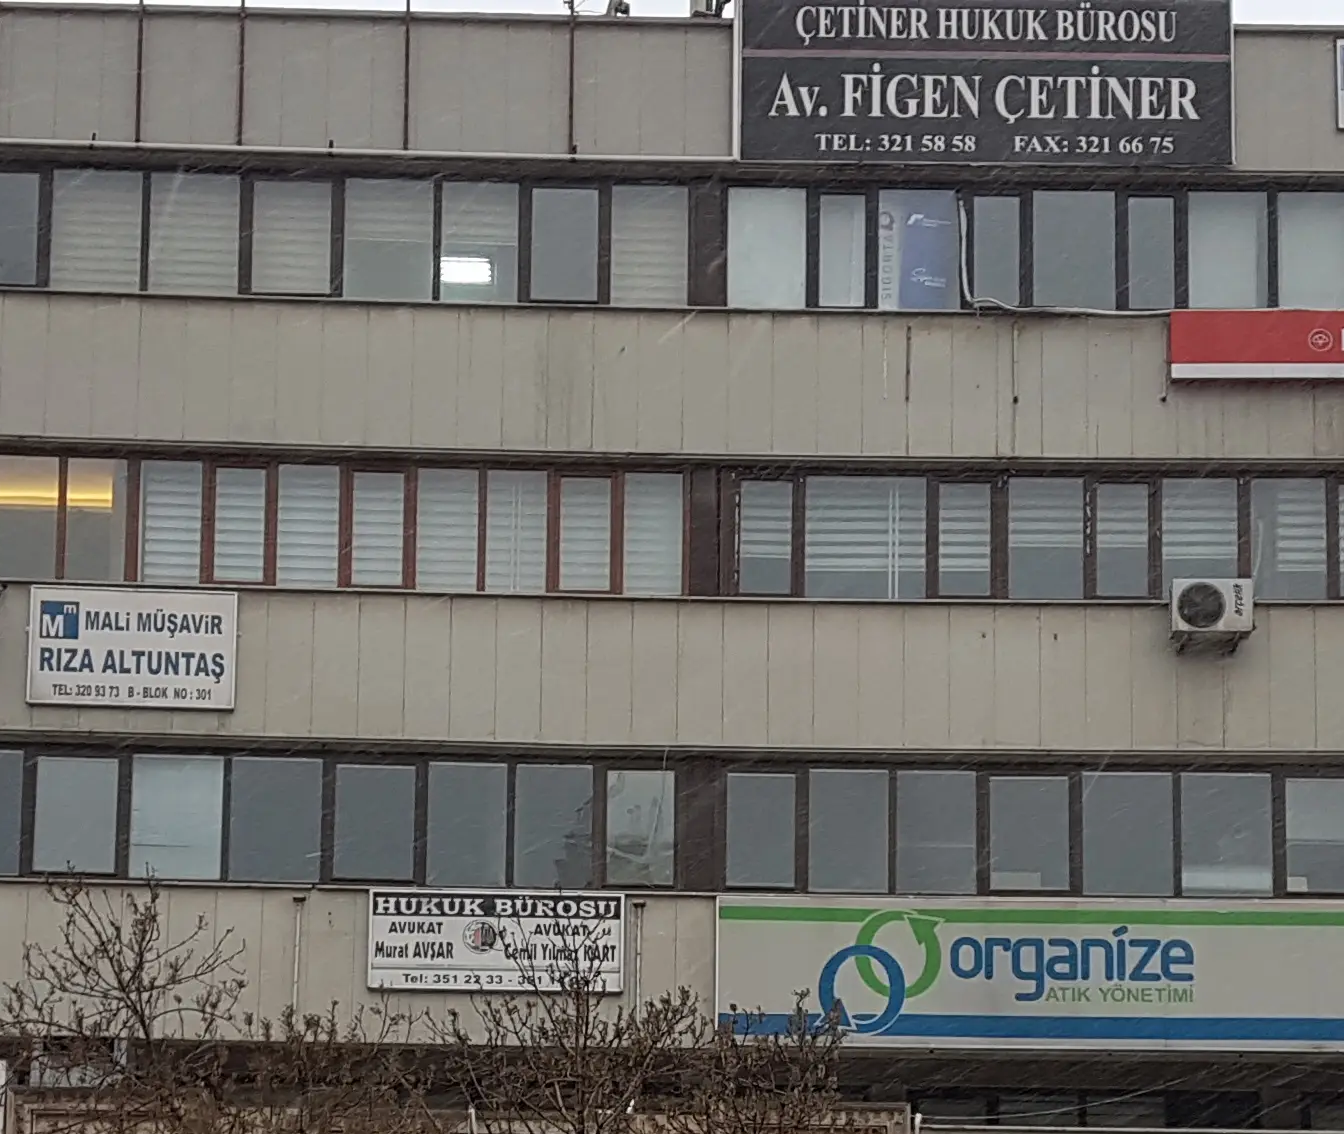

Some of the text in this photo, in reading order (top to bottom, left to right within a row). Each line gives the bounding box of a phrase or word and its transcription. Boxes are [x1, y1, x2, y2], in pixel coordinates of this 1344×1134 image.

[795, 0, 1178, 46] ÇETİNER HUKUK BÜROSU
[769, 62, 1201, 125] Av. FİGEN ÇETİNER
[815, 133, 1174, 154] TEL: 321 58 58 FAX: 321 66 75
[39, 647, 225, 684] RIZA ALTUNTAŞ
[52, 684, 73, 696] TEL:
[375, 896, 618, 918] HUKUK BÜROSU
[388, 921, 444, 934] AVUKAT
[375, 941, 408, 959] Murat
[412, 942, 454, 961] AVŞAR
[949, 924, 1195, 1002] organize
[402, 974, 428, 984] Tel:
[433, 974, 458, 984] 351
[1044, 984, 1195, 1003] ATIK YÖNETİMİ
